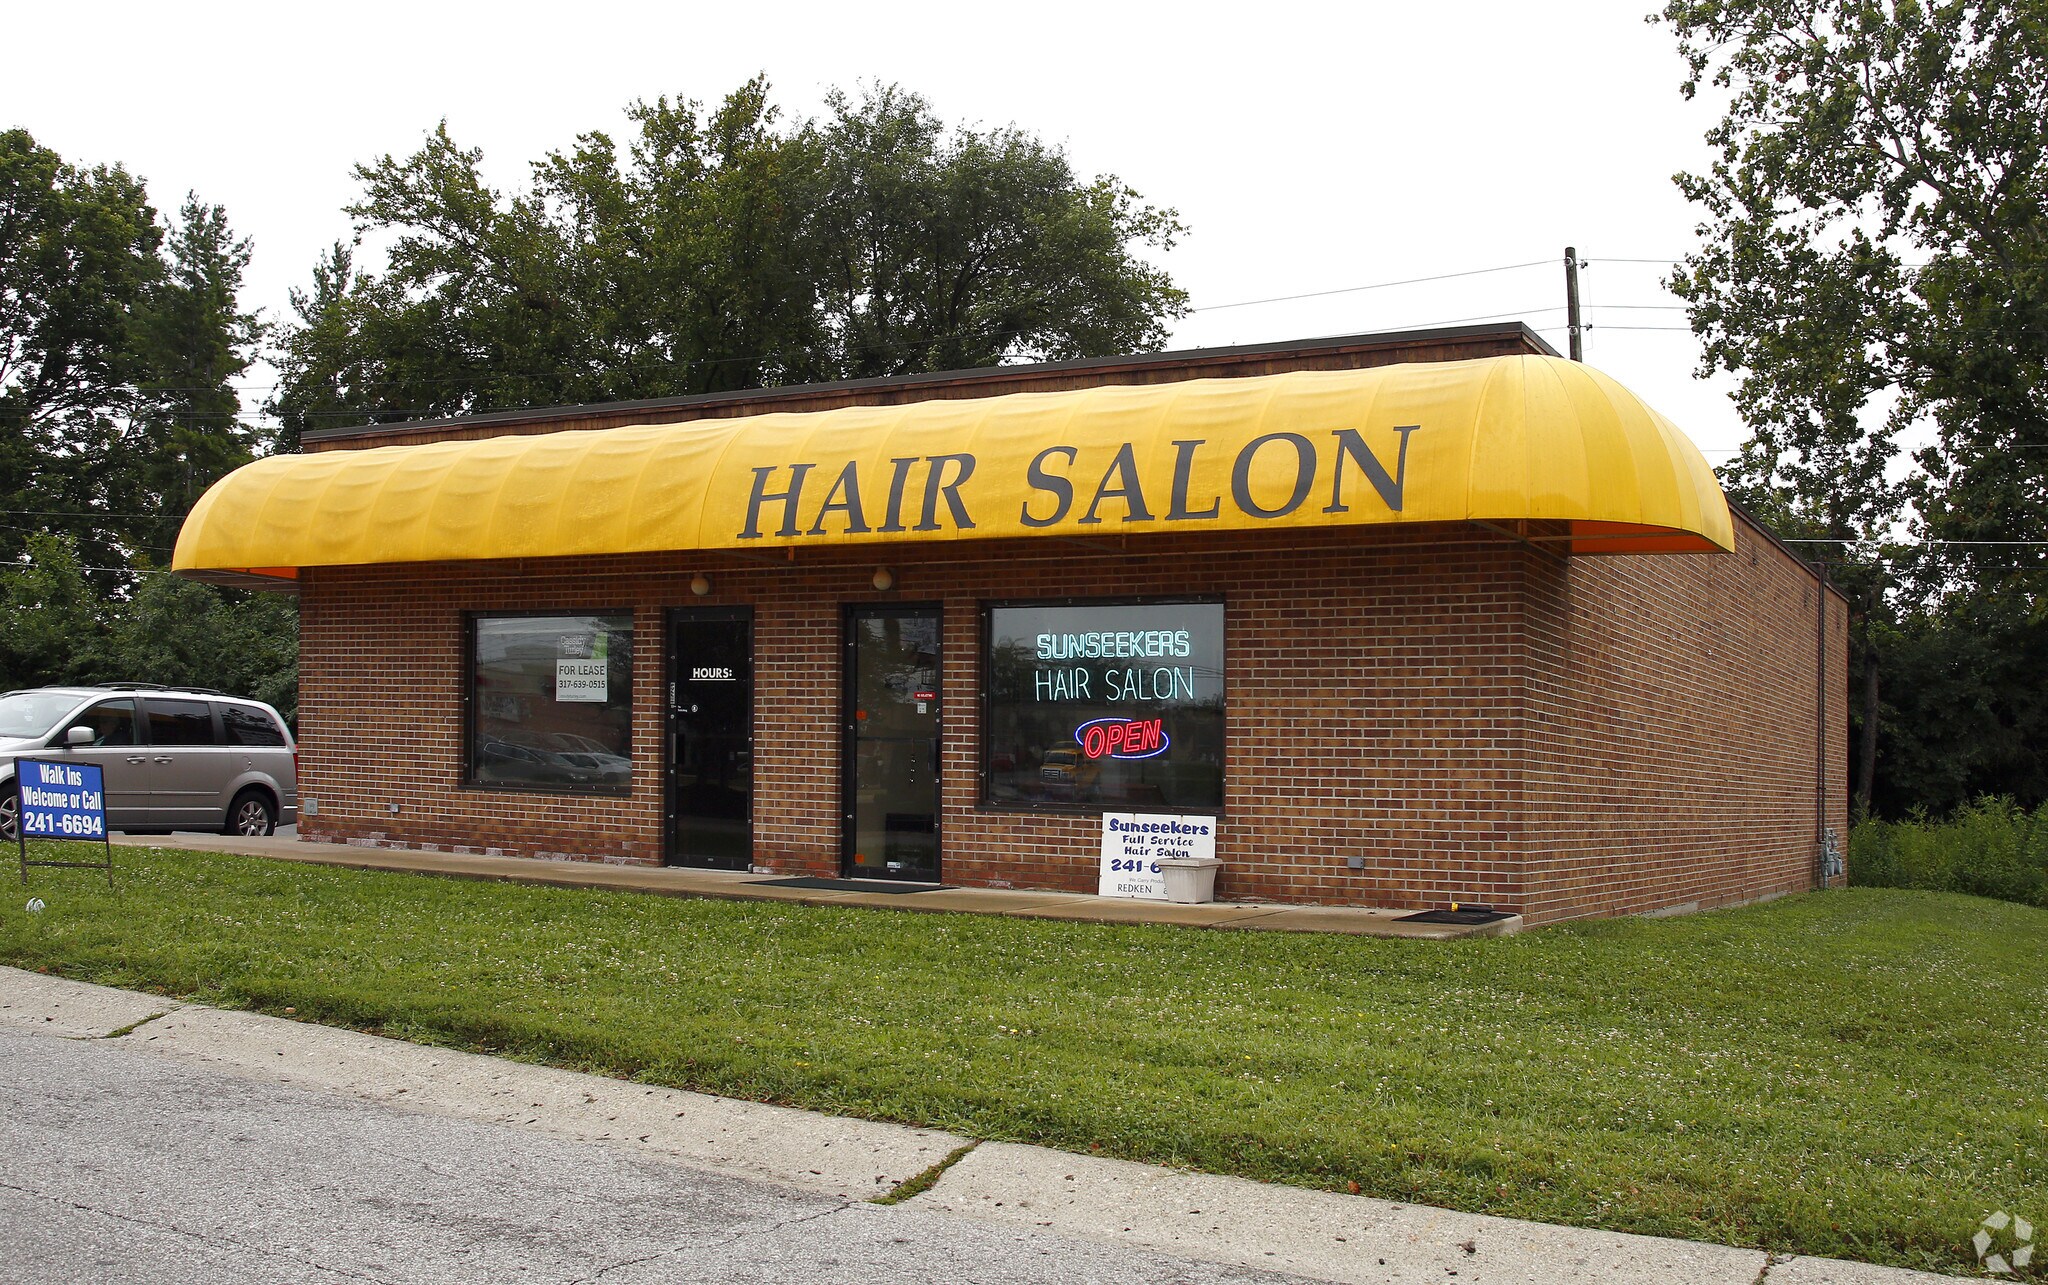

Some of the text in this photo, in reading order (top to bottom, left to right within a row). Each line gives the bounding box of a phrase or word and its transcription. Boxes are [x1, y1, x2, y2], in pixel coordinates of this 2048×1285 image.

[736, 424, 1420, 539] HAIR SALON
[1036, 630, 1191, 660] SUNSEEKERS
[559, 665, 605, 676] FOR LEASE
[692, 667, 733, 678] HOURS:
[558, 680, 606, 689] 317-639-0515
[1035, 667, 1194, 702] HAIR SALON
[1084, 718, 1162, 759] OPEN
[40, 764, 83, 787] Walk Ins
[22, 786, 102, 811] Welcome or Call
[24, 811, 103, 835] 241-6694
[1109, 818, 1209, 836] Sunseekers
[1122, 835, 1195, 847] Full Service
[1124, 846, 1190, 858] Hair Salon
[1111, 859, 1162, 874] 241-6
[1117, 883, 1153, 894] REDKEN
